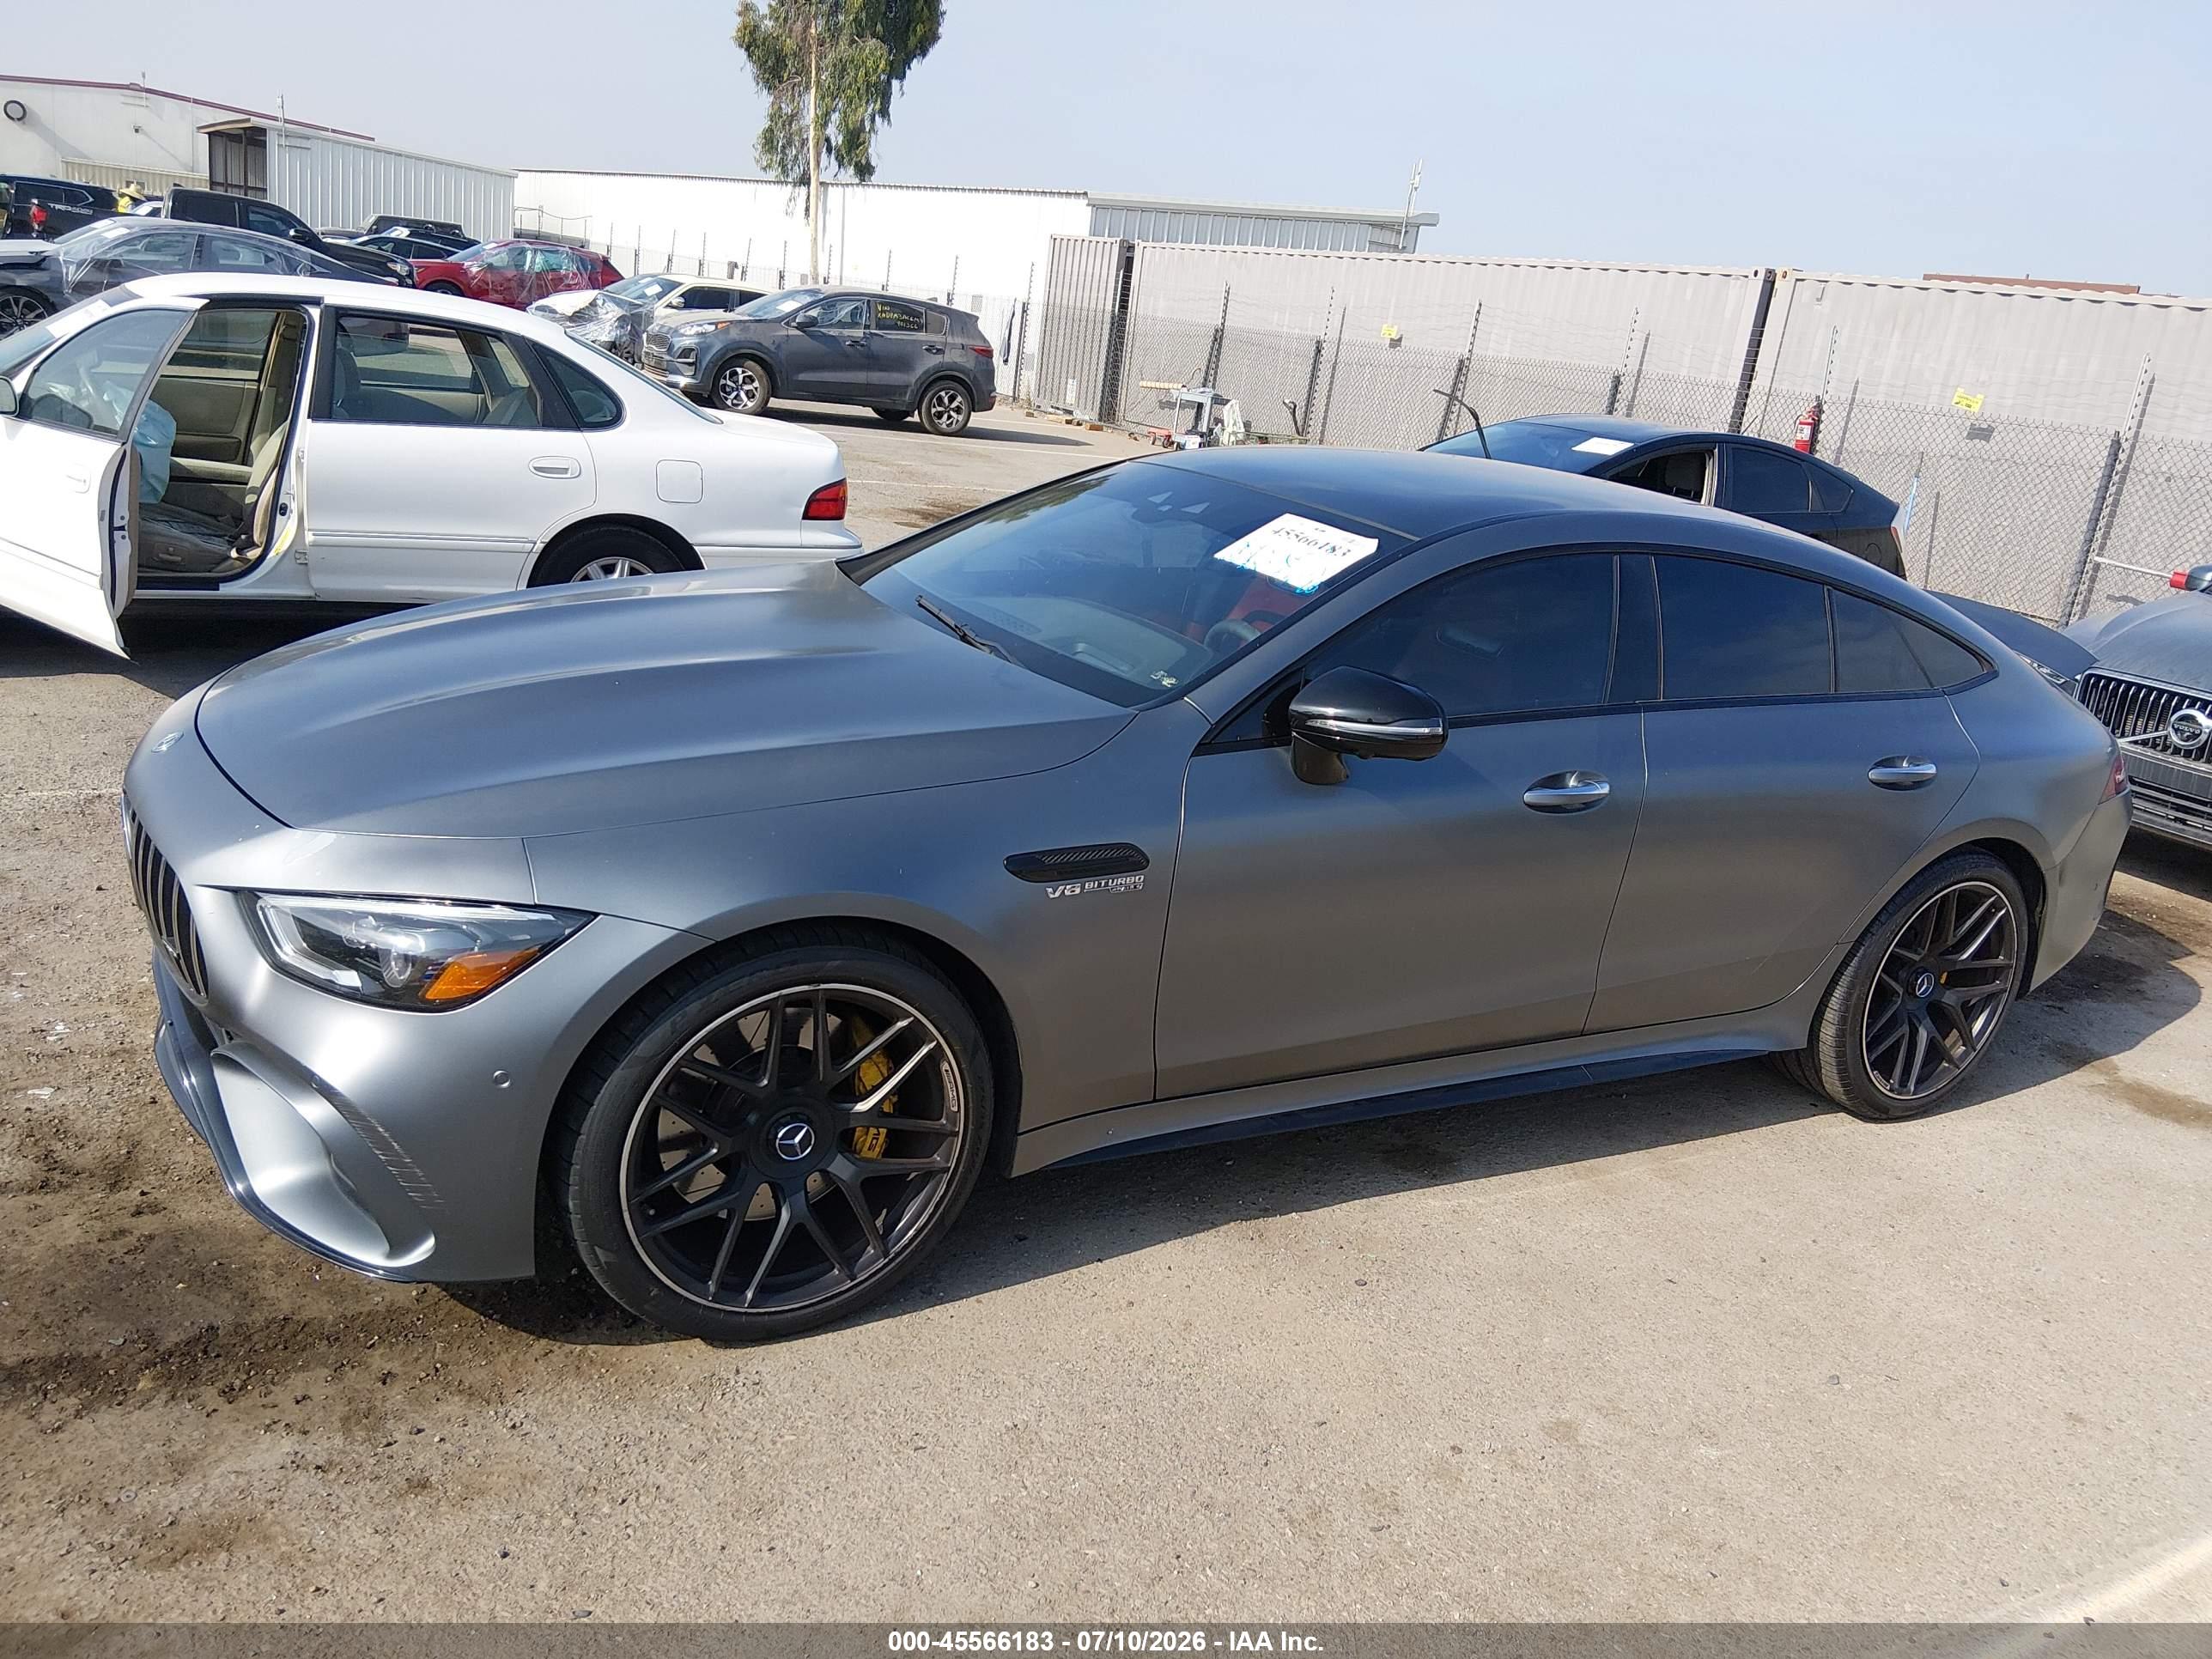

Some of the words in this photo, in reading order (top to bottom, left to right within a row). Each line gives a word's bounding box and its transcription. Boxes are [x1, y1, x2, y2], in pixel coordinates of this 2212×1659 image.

[2173, 723, 2201, 734] VOLVO
[1045, 883, 1082, 899] V8
[1085, 875, 1145, 890] BITURBO
